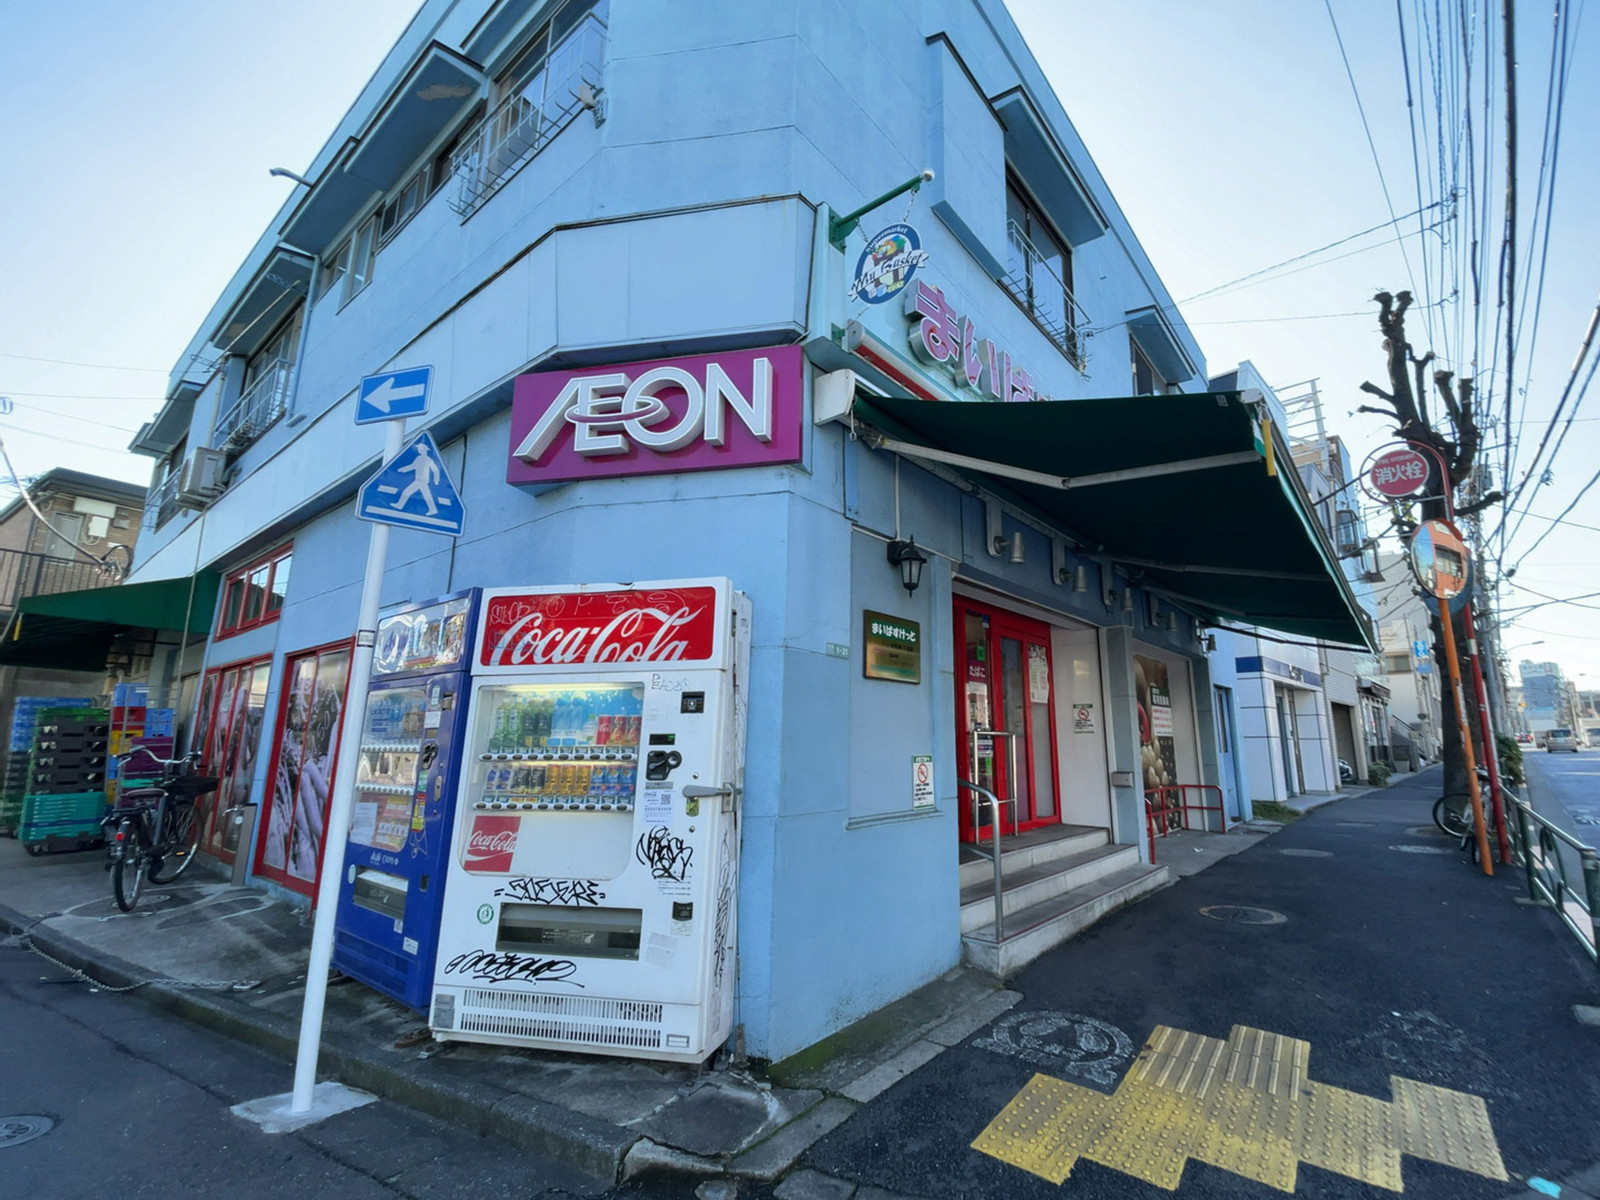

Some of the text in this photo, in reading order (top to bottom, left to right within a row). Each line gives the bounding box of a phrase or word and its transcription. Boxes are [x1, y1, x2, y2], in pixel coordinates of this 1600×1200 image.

[1375, 460, 1424, 486] 消火栓
[490, 604, 708, 666] Coca-Cola
[871, 622, 916, 642] まいばすけっと
[969, 665, 986, 678] たばこ
[470, 830, 518, 851] Coca-Cola
